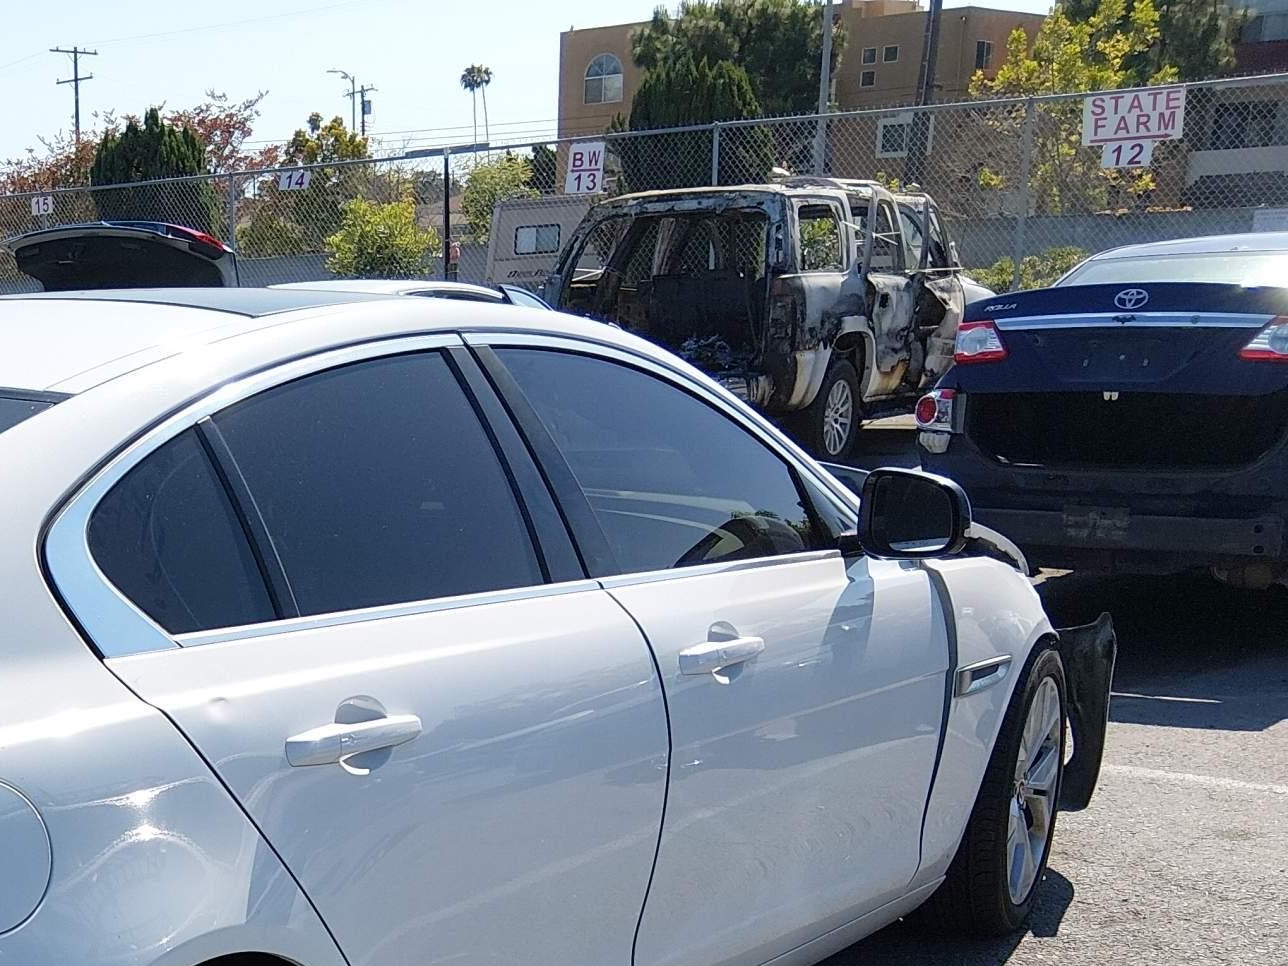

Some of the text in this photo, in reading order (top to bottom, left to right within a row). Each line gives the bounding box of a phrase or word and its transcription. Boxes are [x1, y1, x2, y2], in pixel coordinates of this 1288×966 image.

[1091, 89, 1182, 117] STATE
[1093, 110, 1176, 137] FARM
[572, 150, 601, 168] BW
[1112, 143, 1144, 166] 12
[286, 172, 305, 189] 14
[574, 173, 597, 192] 13
[35, 198, 50, 214] 15
